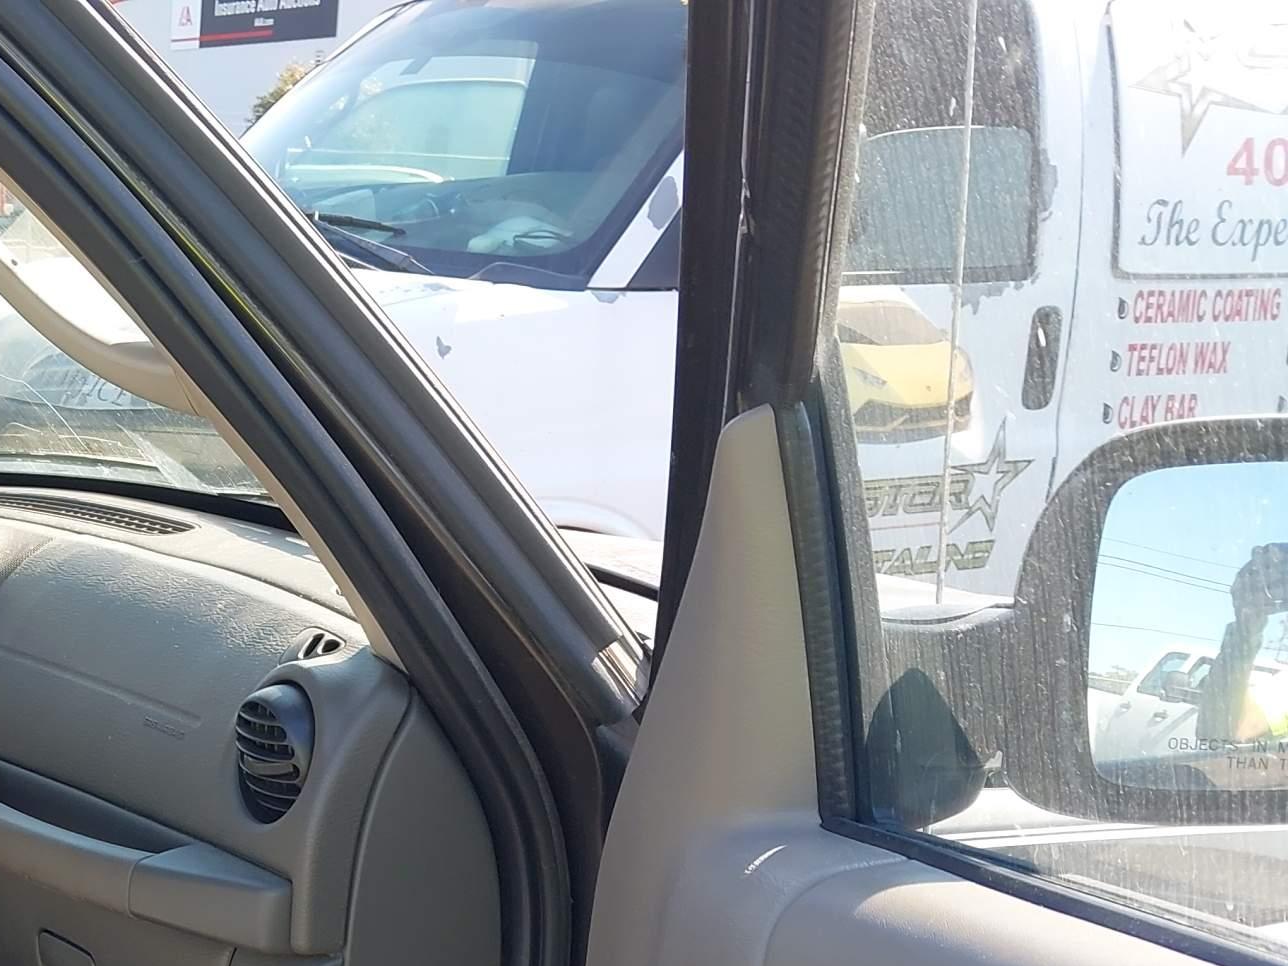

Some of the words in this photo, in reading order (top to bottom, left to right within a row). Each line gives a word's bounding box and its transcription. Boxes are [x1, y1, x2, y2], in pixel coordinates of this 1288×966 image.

[1137, 199, 1200, 246] The
[1211, 200, 1288, 262] Expe
[1133, 290, 1208, 324] CERAMIC
[1212, 288, 1281, 322] COATING
[1127, 343, 1190, 376] TEFLON
[1193, 341, 1231, 374] WAX
[1117, 394, 1161, 429] CLAY
[1164, 394, 1198, 419] BAR
[1168, 737, 1239, 752] OBJECTS
[1252, 740, 1268, 753] IN
[1227, 756, 1269, 770] THAN
